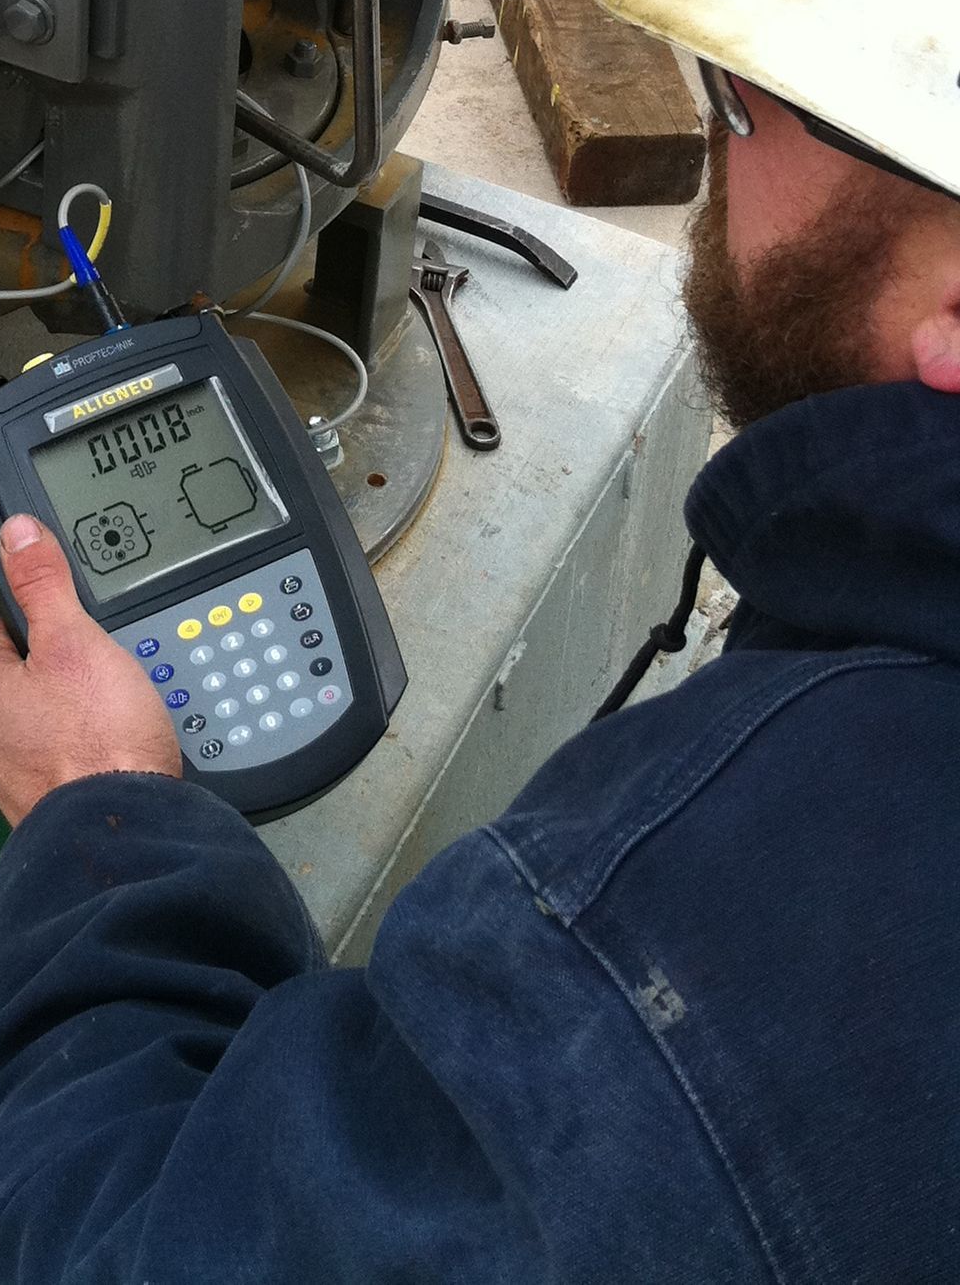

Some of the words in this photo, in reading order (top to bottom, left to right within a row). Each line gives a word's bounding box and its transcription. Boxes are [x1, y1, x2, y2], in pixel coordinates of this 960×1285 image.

[71, 376, 155, 419] ALIGNEO
[257, 622, 269, 635] 3
[227, 635, 238, 648] 2
[303, 632, 321, 645] CLR
[197, 649, 206, 662] 1
[240, 661, 252, 674] 5
[210, 675, 221, 687] 4
[282, 674, 294, 687] 9
[252, 688, 264, 701] 8
[221, 702, 231, 715] 7
[265, 715, 277, 728] 0
